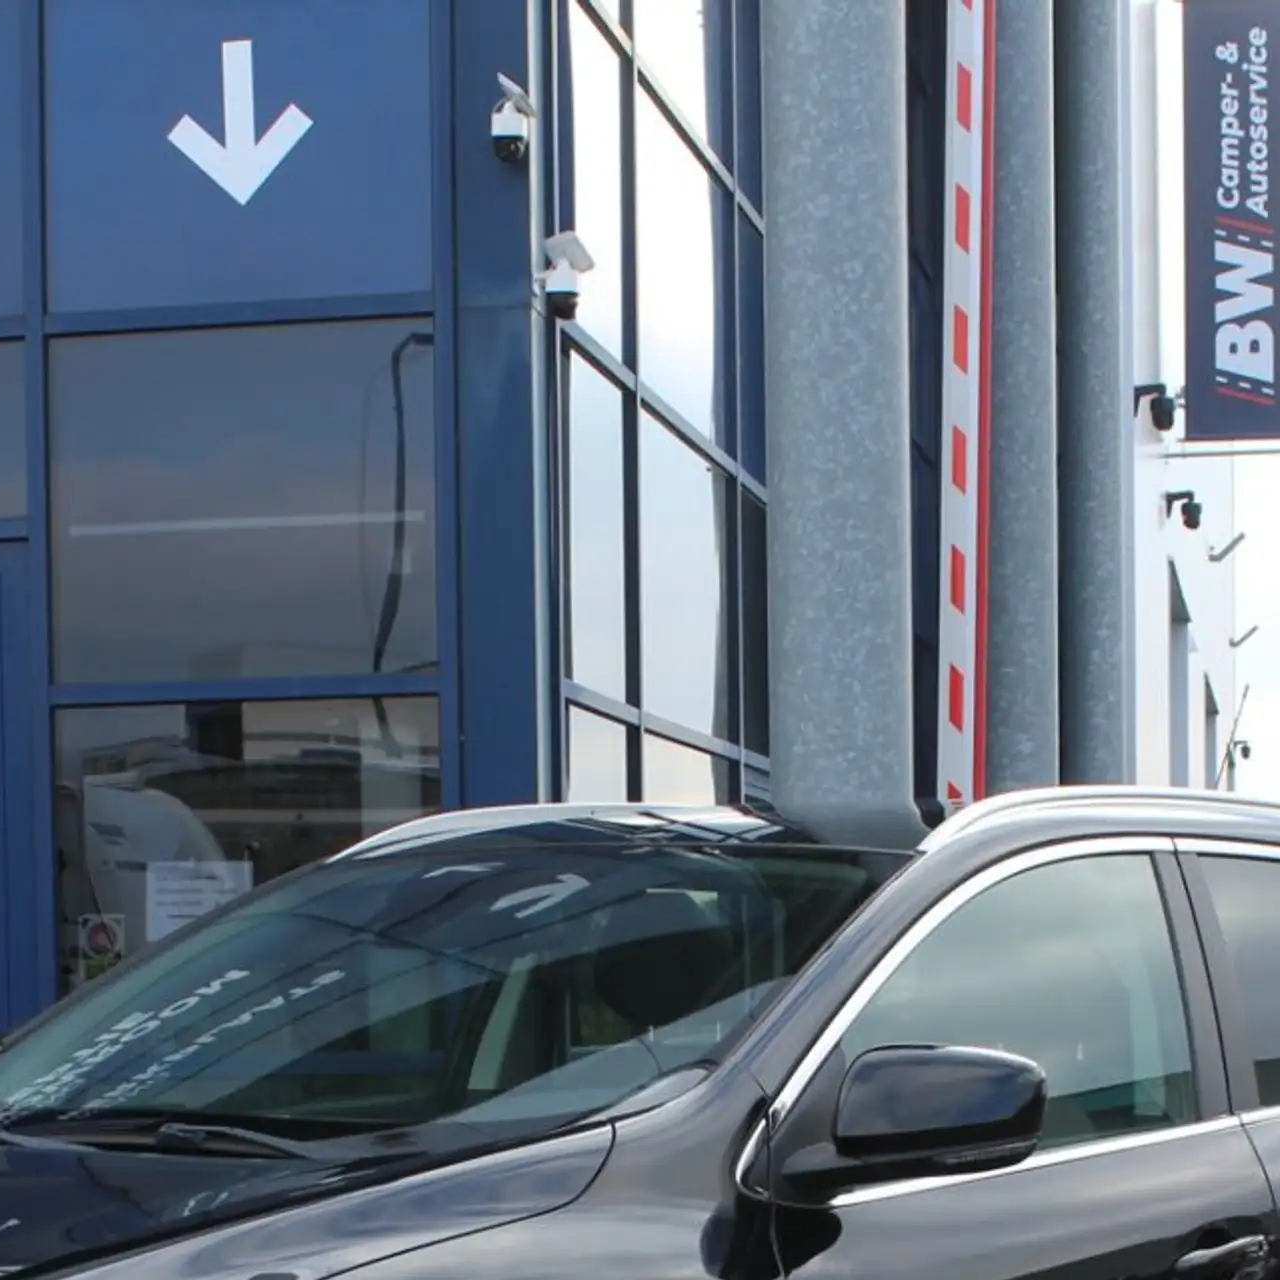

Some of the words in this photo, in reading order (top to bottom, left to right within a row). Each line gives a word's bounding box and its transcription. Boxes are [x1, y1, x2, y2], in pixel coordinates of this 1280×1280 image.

[1216, 73, 1245, 210] Camper-
[1242, 26, 1269, 219] Autoservice
[1215, 240, 1275, 383] BW
